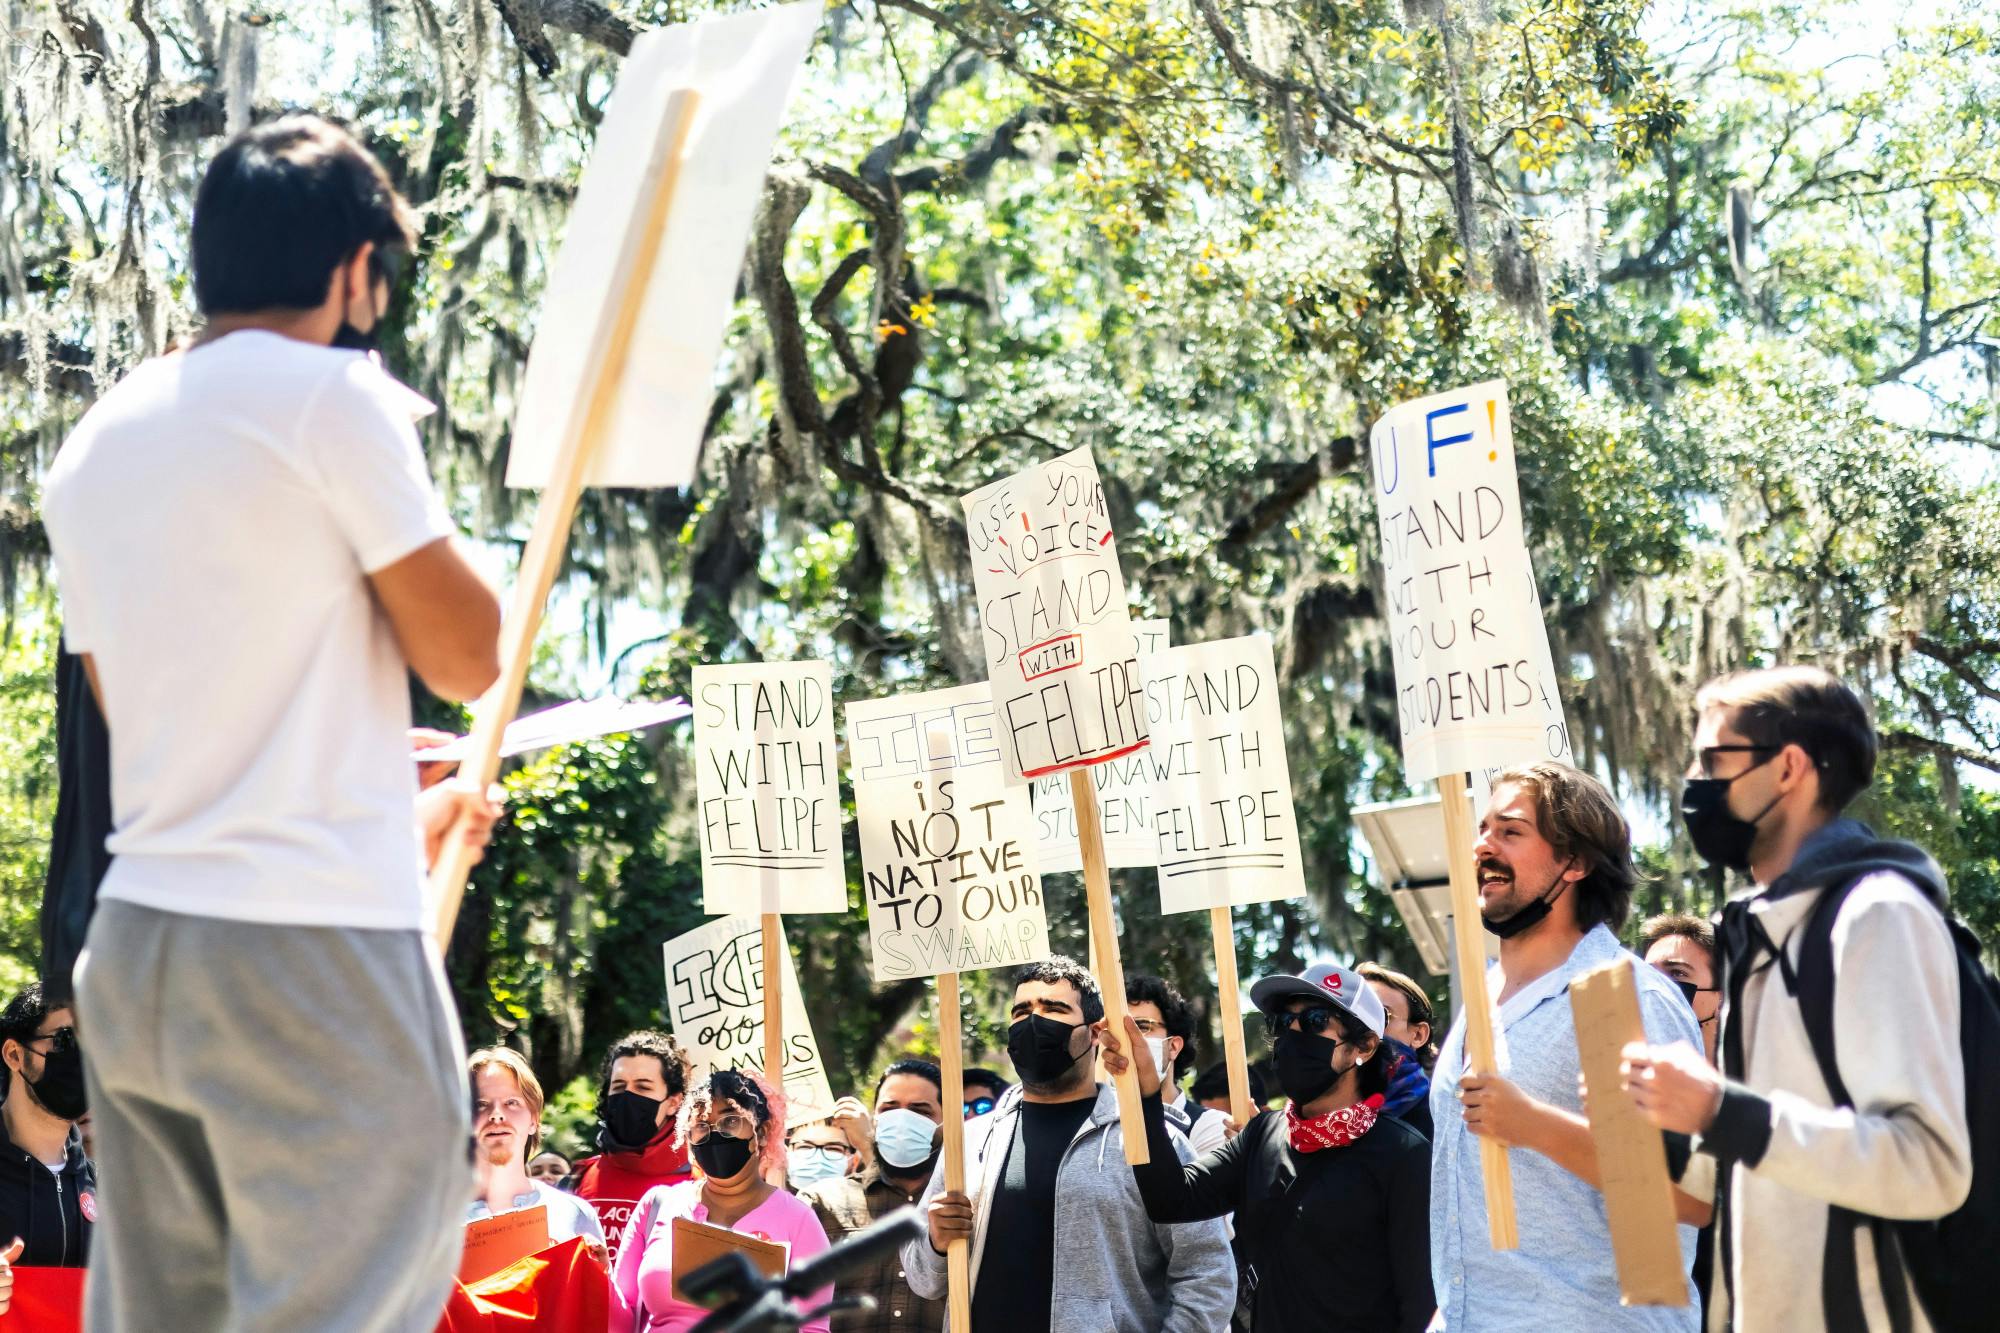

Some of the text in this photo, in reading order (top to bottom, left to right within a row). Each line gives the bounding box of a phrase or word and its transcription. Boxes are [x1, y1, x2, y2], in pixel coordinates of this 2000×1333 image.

[971, 471, 1105, 552] USE YOUR
[1384, 486, 1504, 570] STAND
[999, 521, 1098, 576] VOICE
[1391, 555, 1492, 615] WITH
[985, 569, 1111, 663] STAND
[1396, 608, 1496, 665] YOUR
[1025, 641, 1075, 675] WITH
[701, 677, 823, 731] STAND
[1006, 658, 1150, 773] FELIPE
[1147, 664, 1260, 724] STAND
[1400, 660, 1532, 736] STUDENTS
[709, 741, 825, 795] WITH
[856, 700, 1002, 781] ICE
[1149, 730, 1261, 782] WITH
[704, 797, 828, 852] FELIPE
[891, 800, 1005, 858] NOT
[1156, 790, 1283, 855] FELIPE
[867, 841, 1024, 901] NATIVE
[878, 874, 1040, 931] TO OUR
[673, 929, 764, 1024] ICE
[878, 919, 1037, 976] SWAMP
